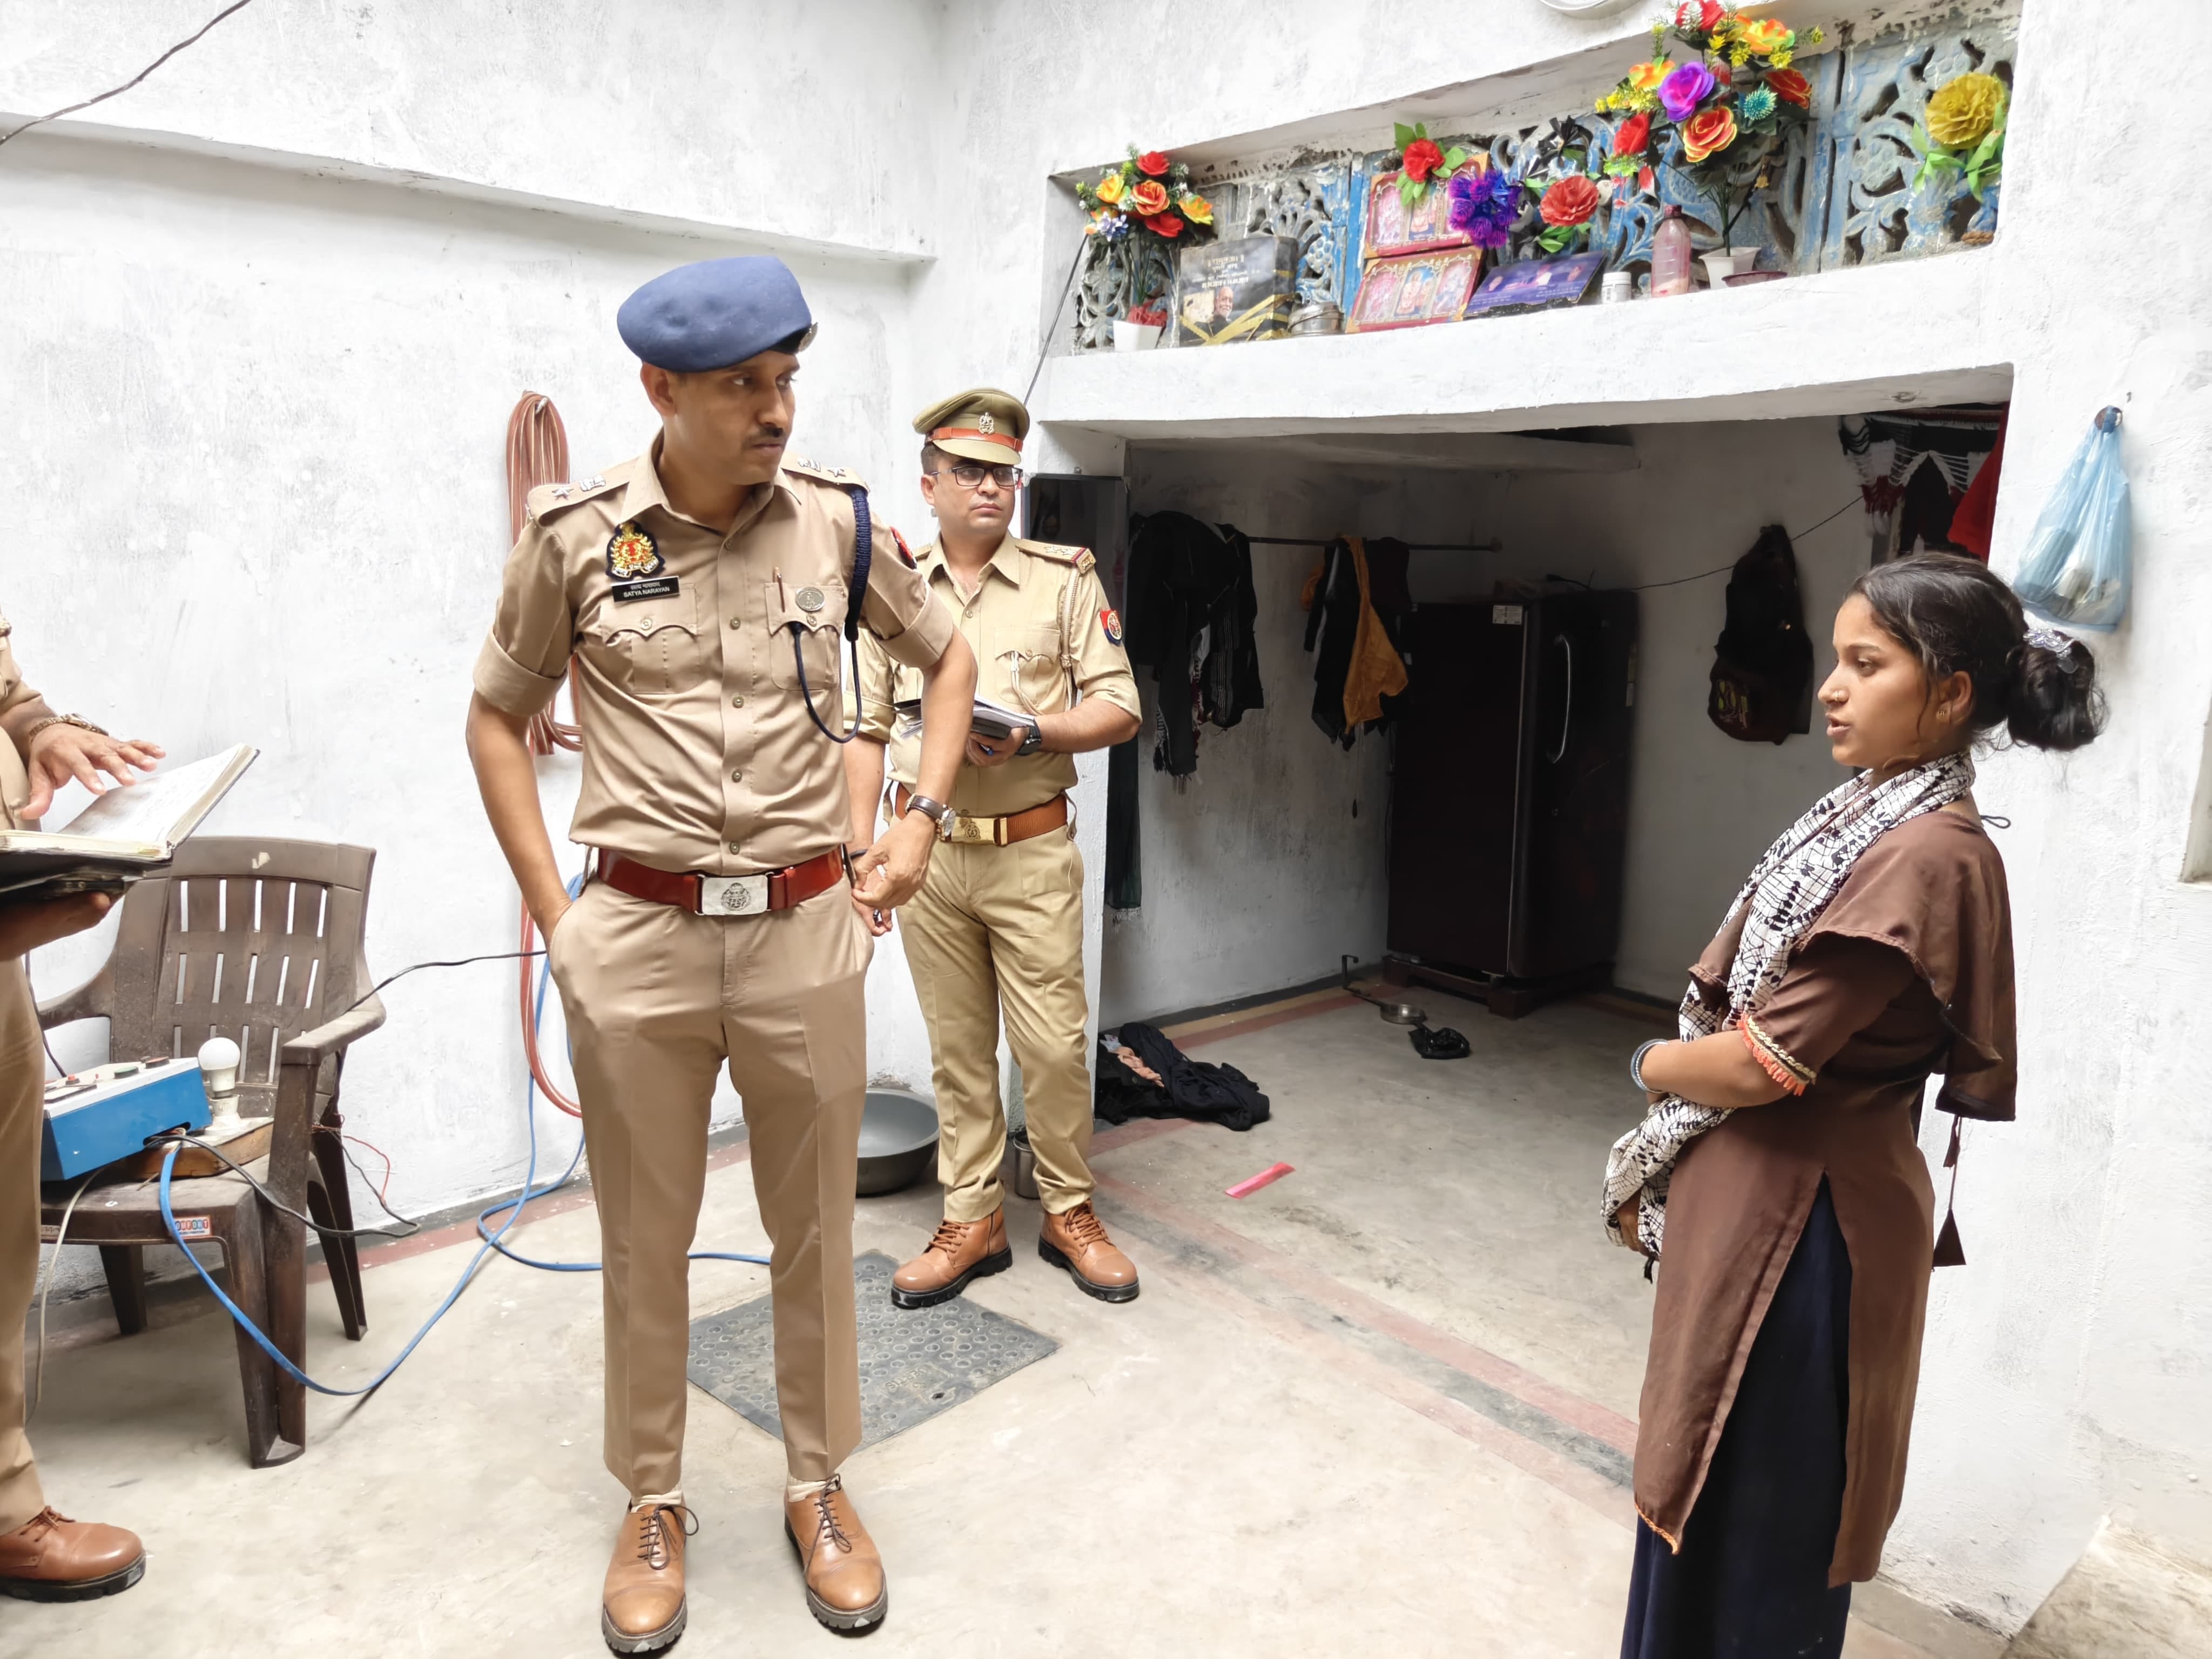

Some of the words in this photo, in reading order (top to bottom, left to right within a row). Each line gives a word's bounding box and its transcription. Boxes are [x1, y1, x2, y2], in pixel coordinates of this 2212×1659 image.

[623, 590, 642, 598] SATYA
[643, 586, 670, 595] NARAYAN
[175, 1219, 208, 1231] OMFORT
